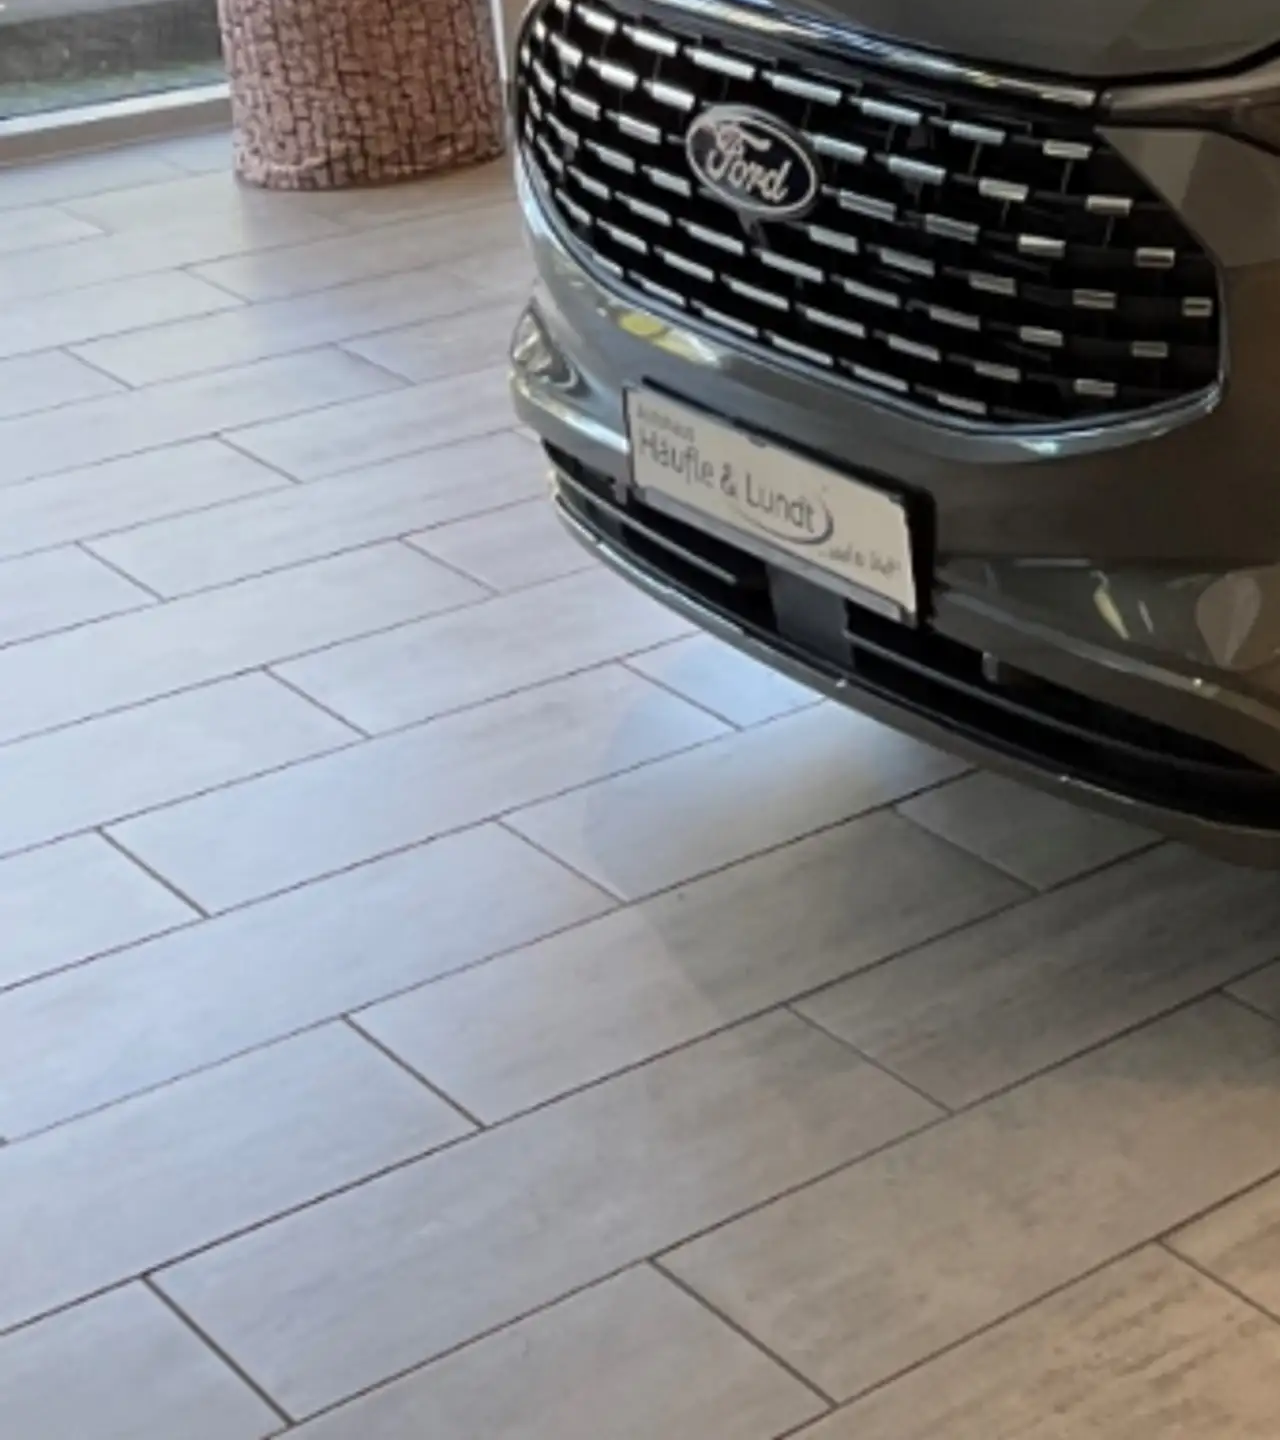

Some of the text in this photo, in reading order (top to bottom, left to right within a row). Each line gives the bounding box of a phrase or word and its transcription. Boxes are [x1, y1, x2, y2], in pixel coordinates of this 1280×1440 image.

[706, 121, 792, 203] Ford
[719, 461, 739, 498] &
[745, 471, 815, 534] Lundt
